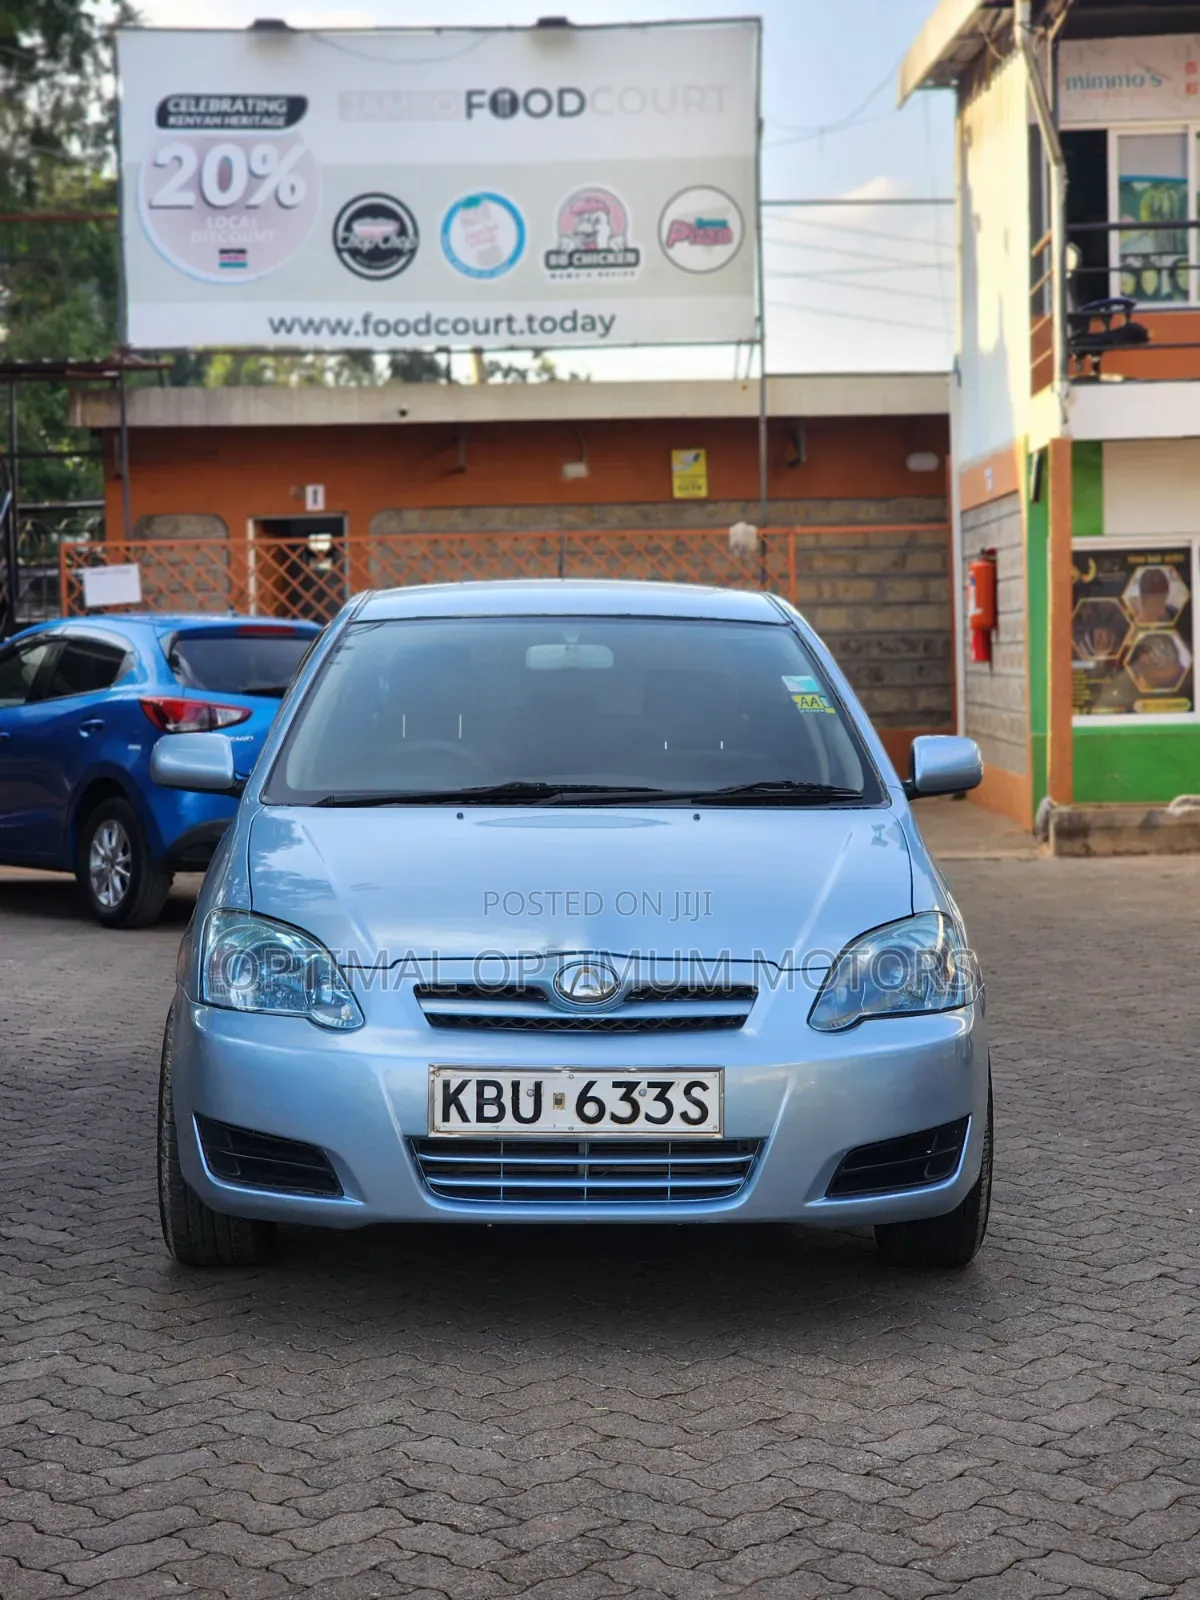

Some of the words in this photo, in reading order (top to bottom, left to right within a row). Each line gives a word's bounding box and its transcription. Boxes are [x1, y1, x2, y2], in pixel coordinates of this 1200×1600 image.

[166, 96, 288, 113] CELEBRATING
[167, 114, 222, 126] KENYAN
[224, 113, 287, 126] HERITAGE
[148, 141, 308, 209] 20%
[572, 250, 637, 266] CHICKEN
[268, 309, 617, 338] www.foodcourt.today
[441, 1079, 543, 1124] KBU
[575, 1080, 710, 1126] 633S
